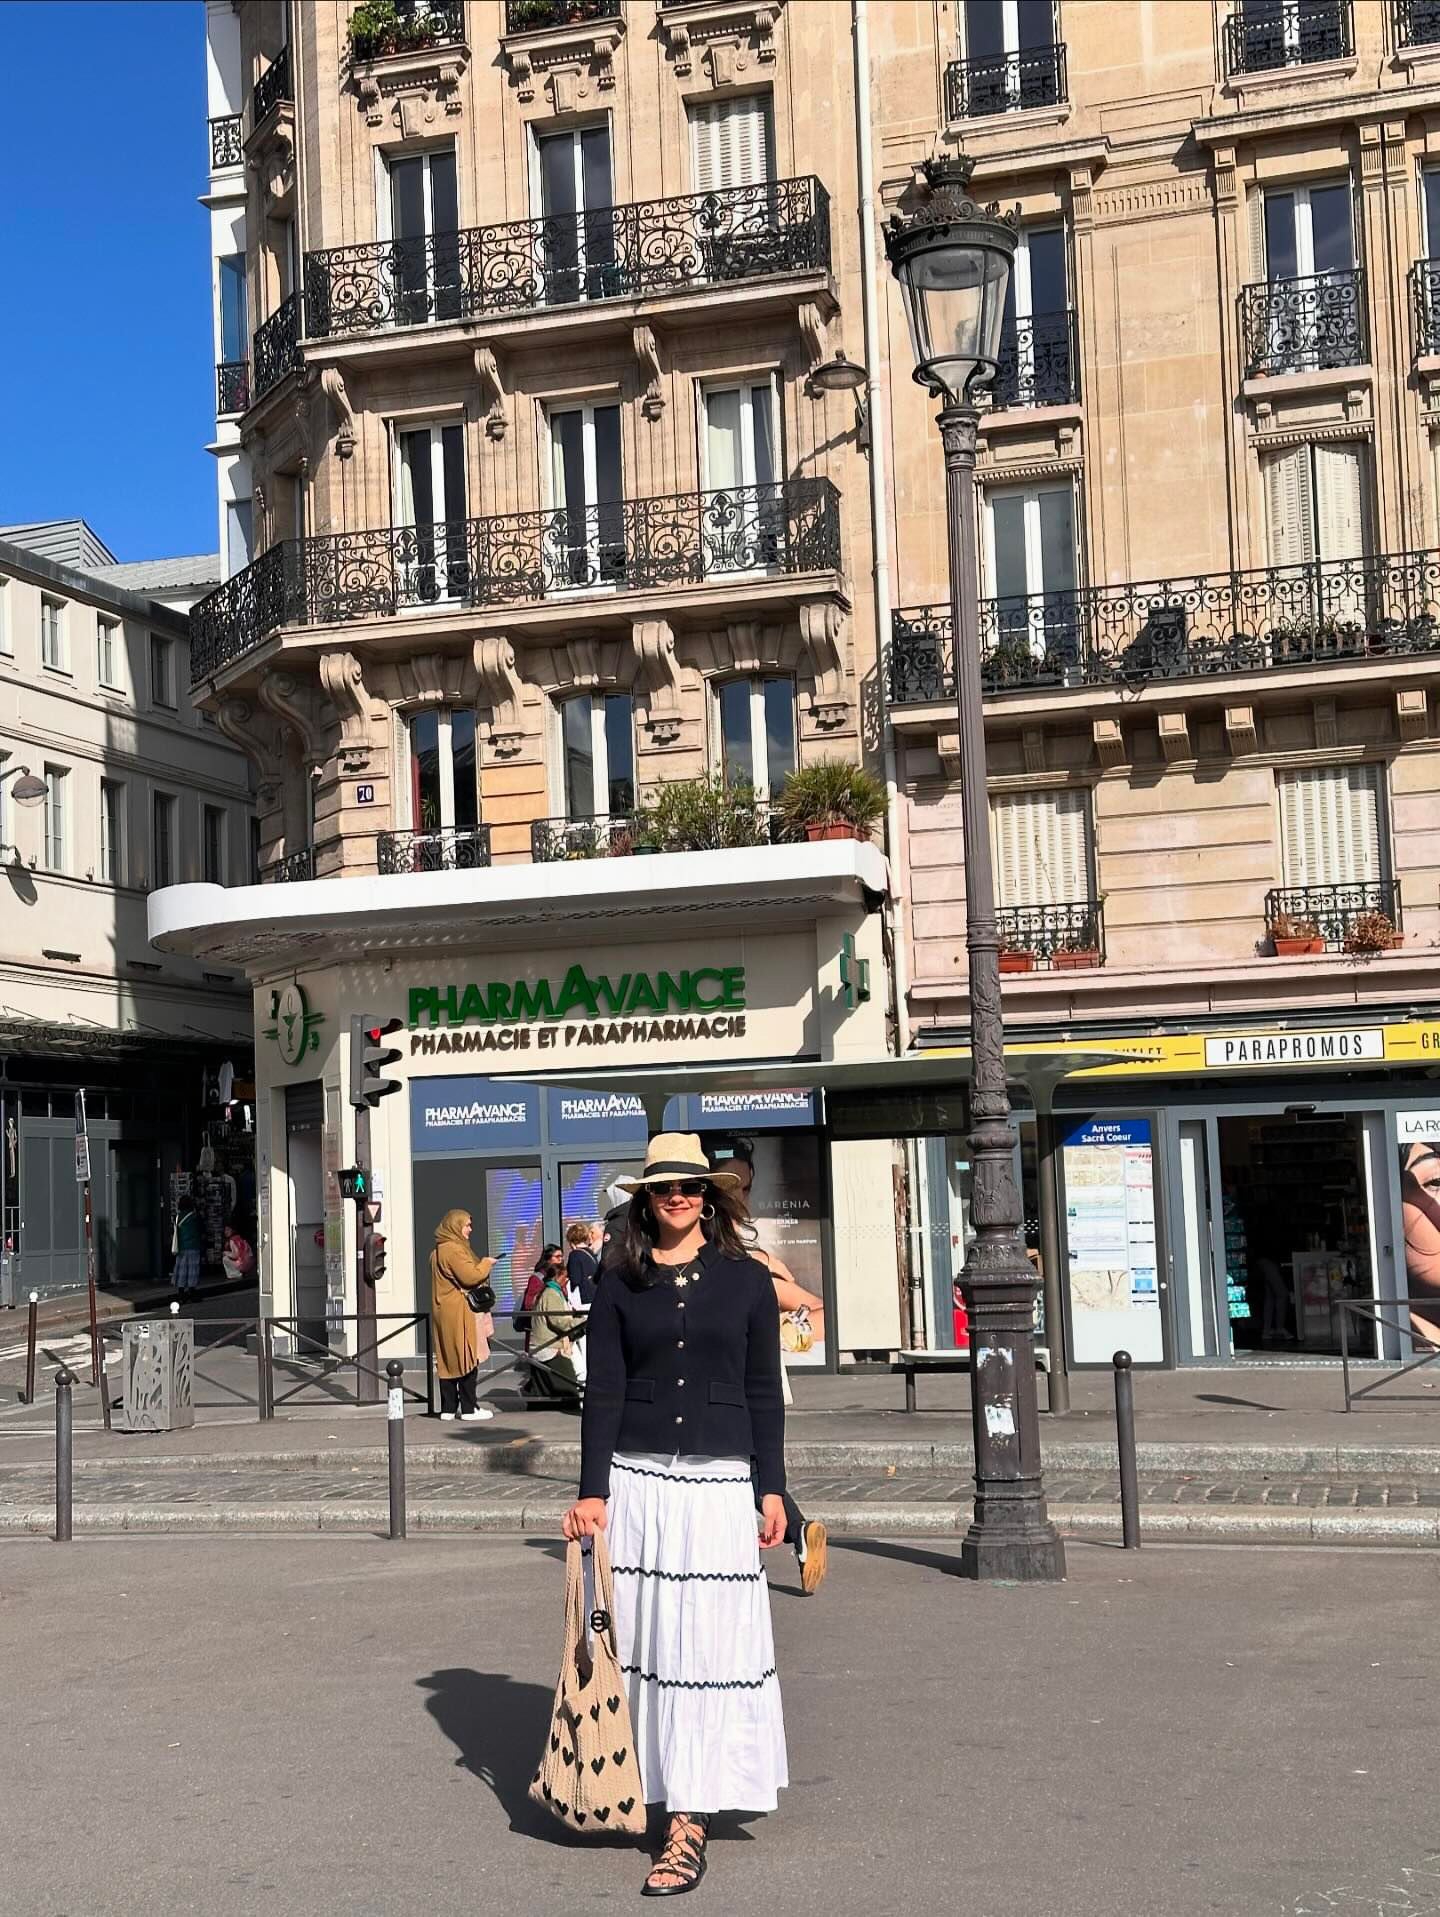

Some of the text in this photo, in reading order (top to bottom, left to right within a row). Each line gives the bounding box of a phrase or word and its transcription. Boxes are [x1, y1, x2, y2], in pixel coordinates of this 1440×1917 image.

[358, 787, 372, 801] 70
[408, 964, 747, 1030] PHARMAVANCE
[411, 1015, 747, 1056] PHARMACIE ET PARAPHARMACIE
[1225, 1034, 1363, 1061] PARAPROMOS
[425, 1101, 526, 1122] PHARMAVANCE
[1091, 1124, 1121, 1133] Anvers
[1405, 1120, 1424, 1133] LA
[1081, 1133, 1132, 1142] Sacré Coeur
